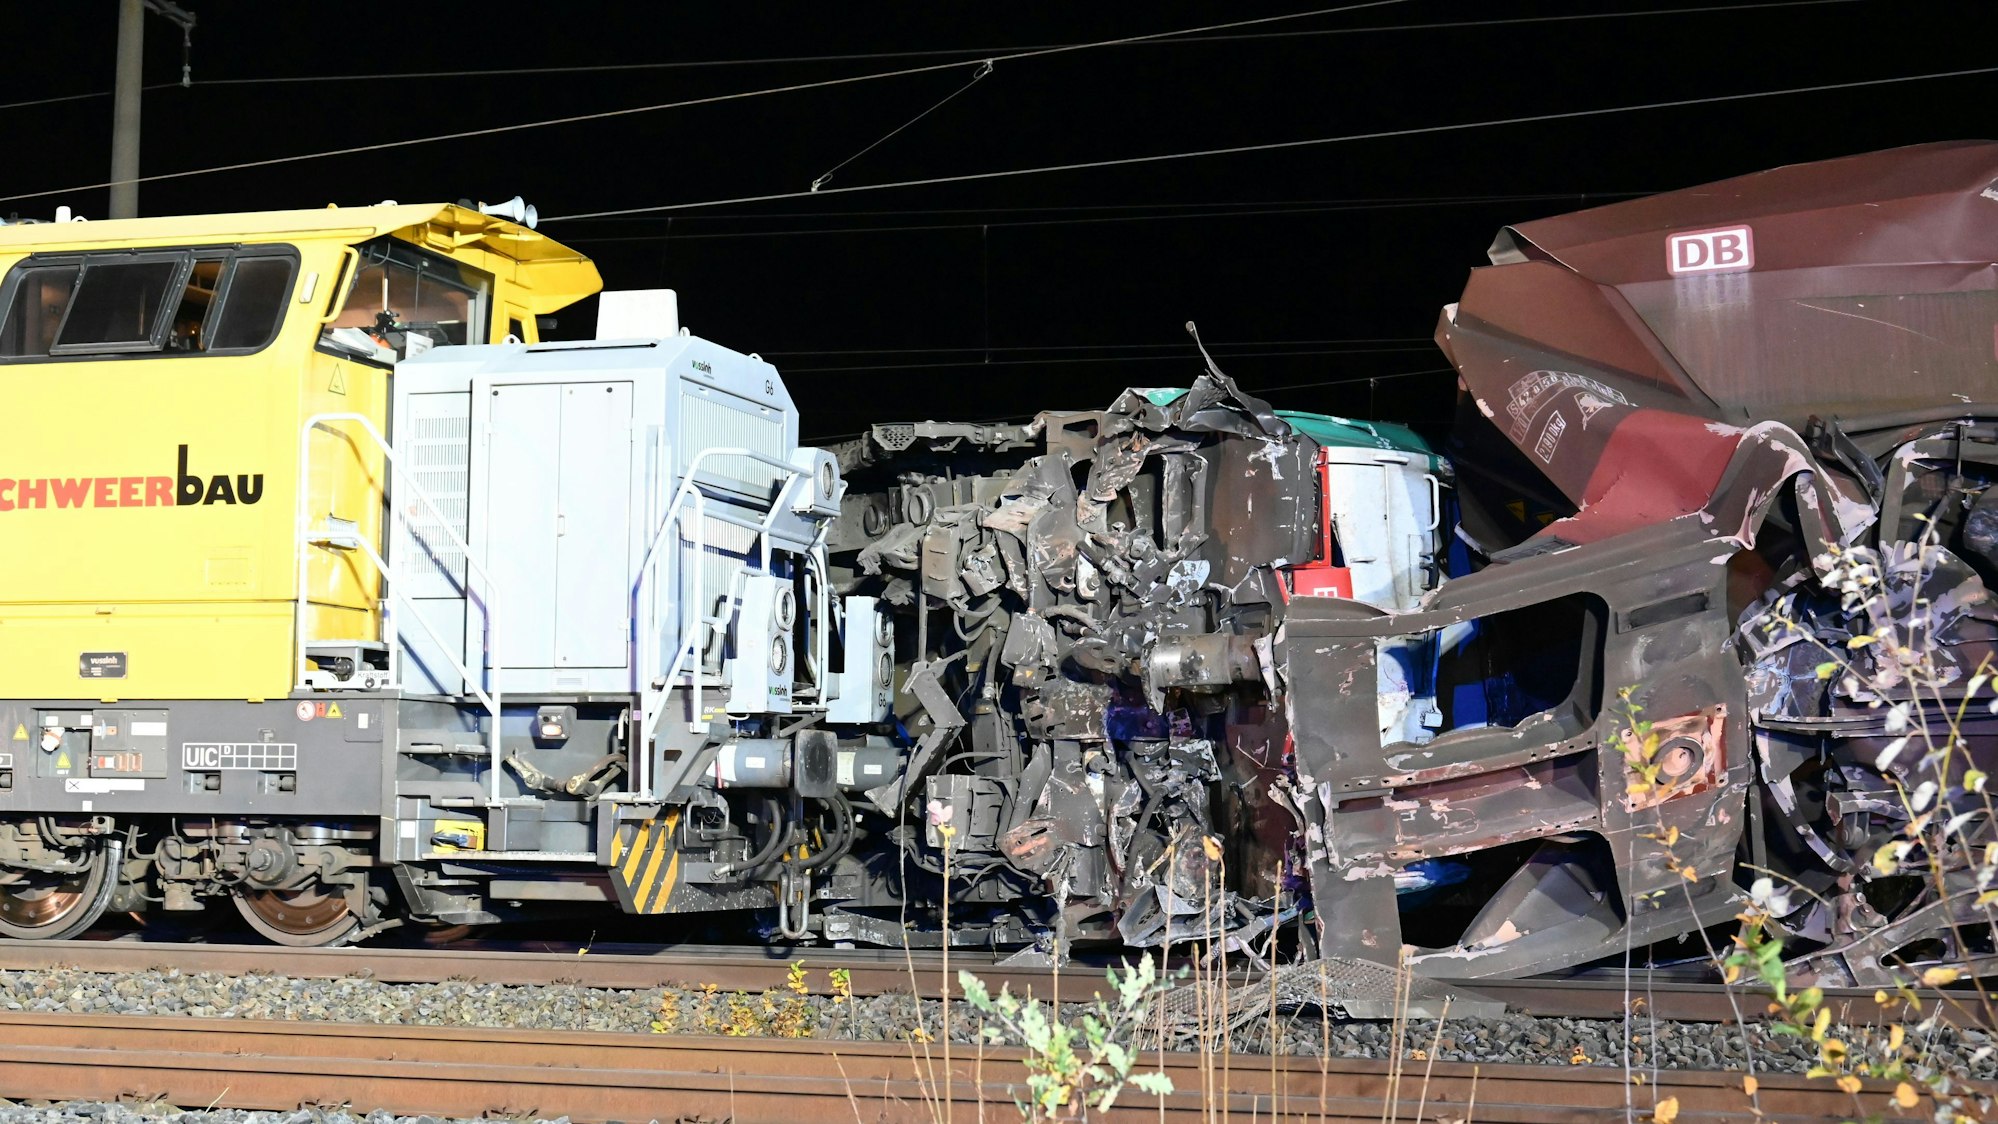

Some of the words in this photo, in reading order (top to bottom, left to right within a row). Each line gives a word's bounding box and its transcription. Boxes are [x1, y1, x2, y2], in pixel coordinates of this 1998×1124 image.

[1677, 234, 1744, 269] DB
[765, 379, 774, 396] G6
[878, 693, 887, 708] G6
[185, 747, 218, 767] UIC
[223, 745, 231, 755] D
